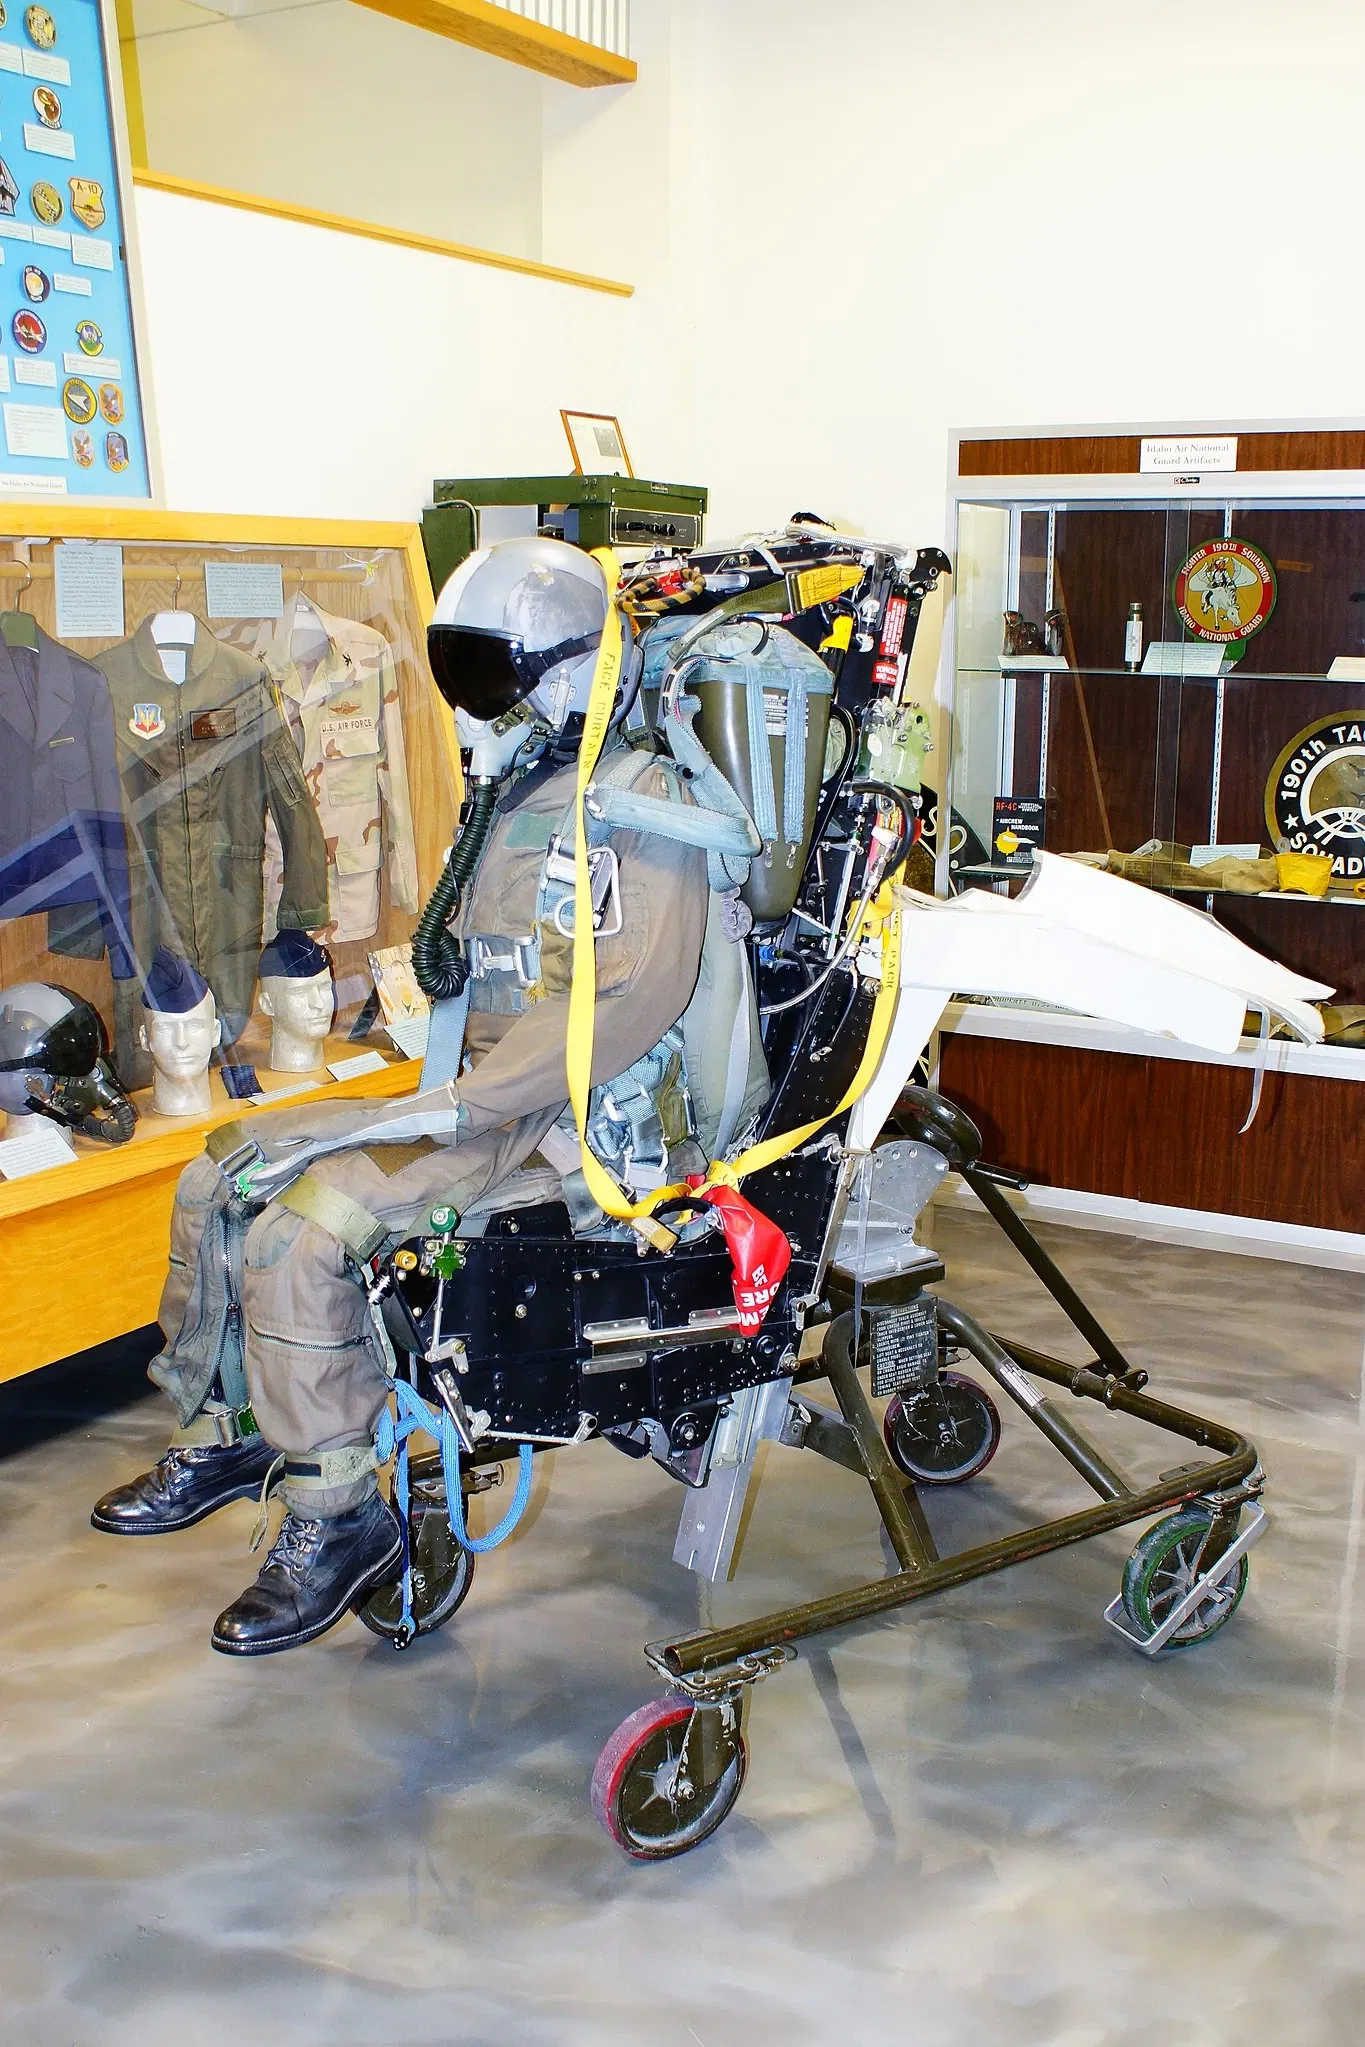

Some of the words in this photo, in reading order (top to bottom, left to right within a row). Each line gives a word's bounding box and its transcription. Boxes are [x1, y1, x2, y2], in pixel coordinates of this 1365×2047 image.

[77, 181, 98, 194] A-10
[1174, 444, 1187, 452] Air
[1191, 444, 1229, 452] National
[1153, 456, 1180, 464] Guard
[1181, 549, 1206, 576] FIGHTER
[1241, 548, 1270, 584] SQUADRON
[1178, 606, 1196, 629] IDAHO
[1198, 628, 1238, 642] NATIONAL
[1240, 614, 1263, 636] GUARD
[322, 724, 336, 732] U.S.
[338, 722, 349, 731] AIR
[351, 719, 372, 728] FORCE
[582, 702, 606, 769] CURTAIN
[1280, 739, 1327, 800] 190th
[996, 802, 1017, 811] RF-4C
